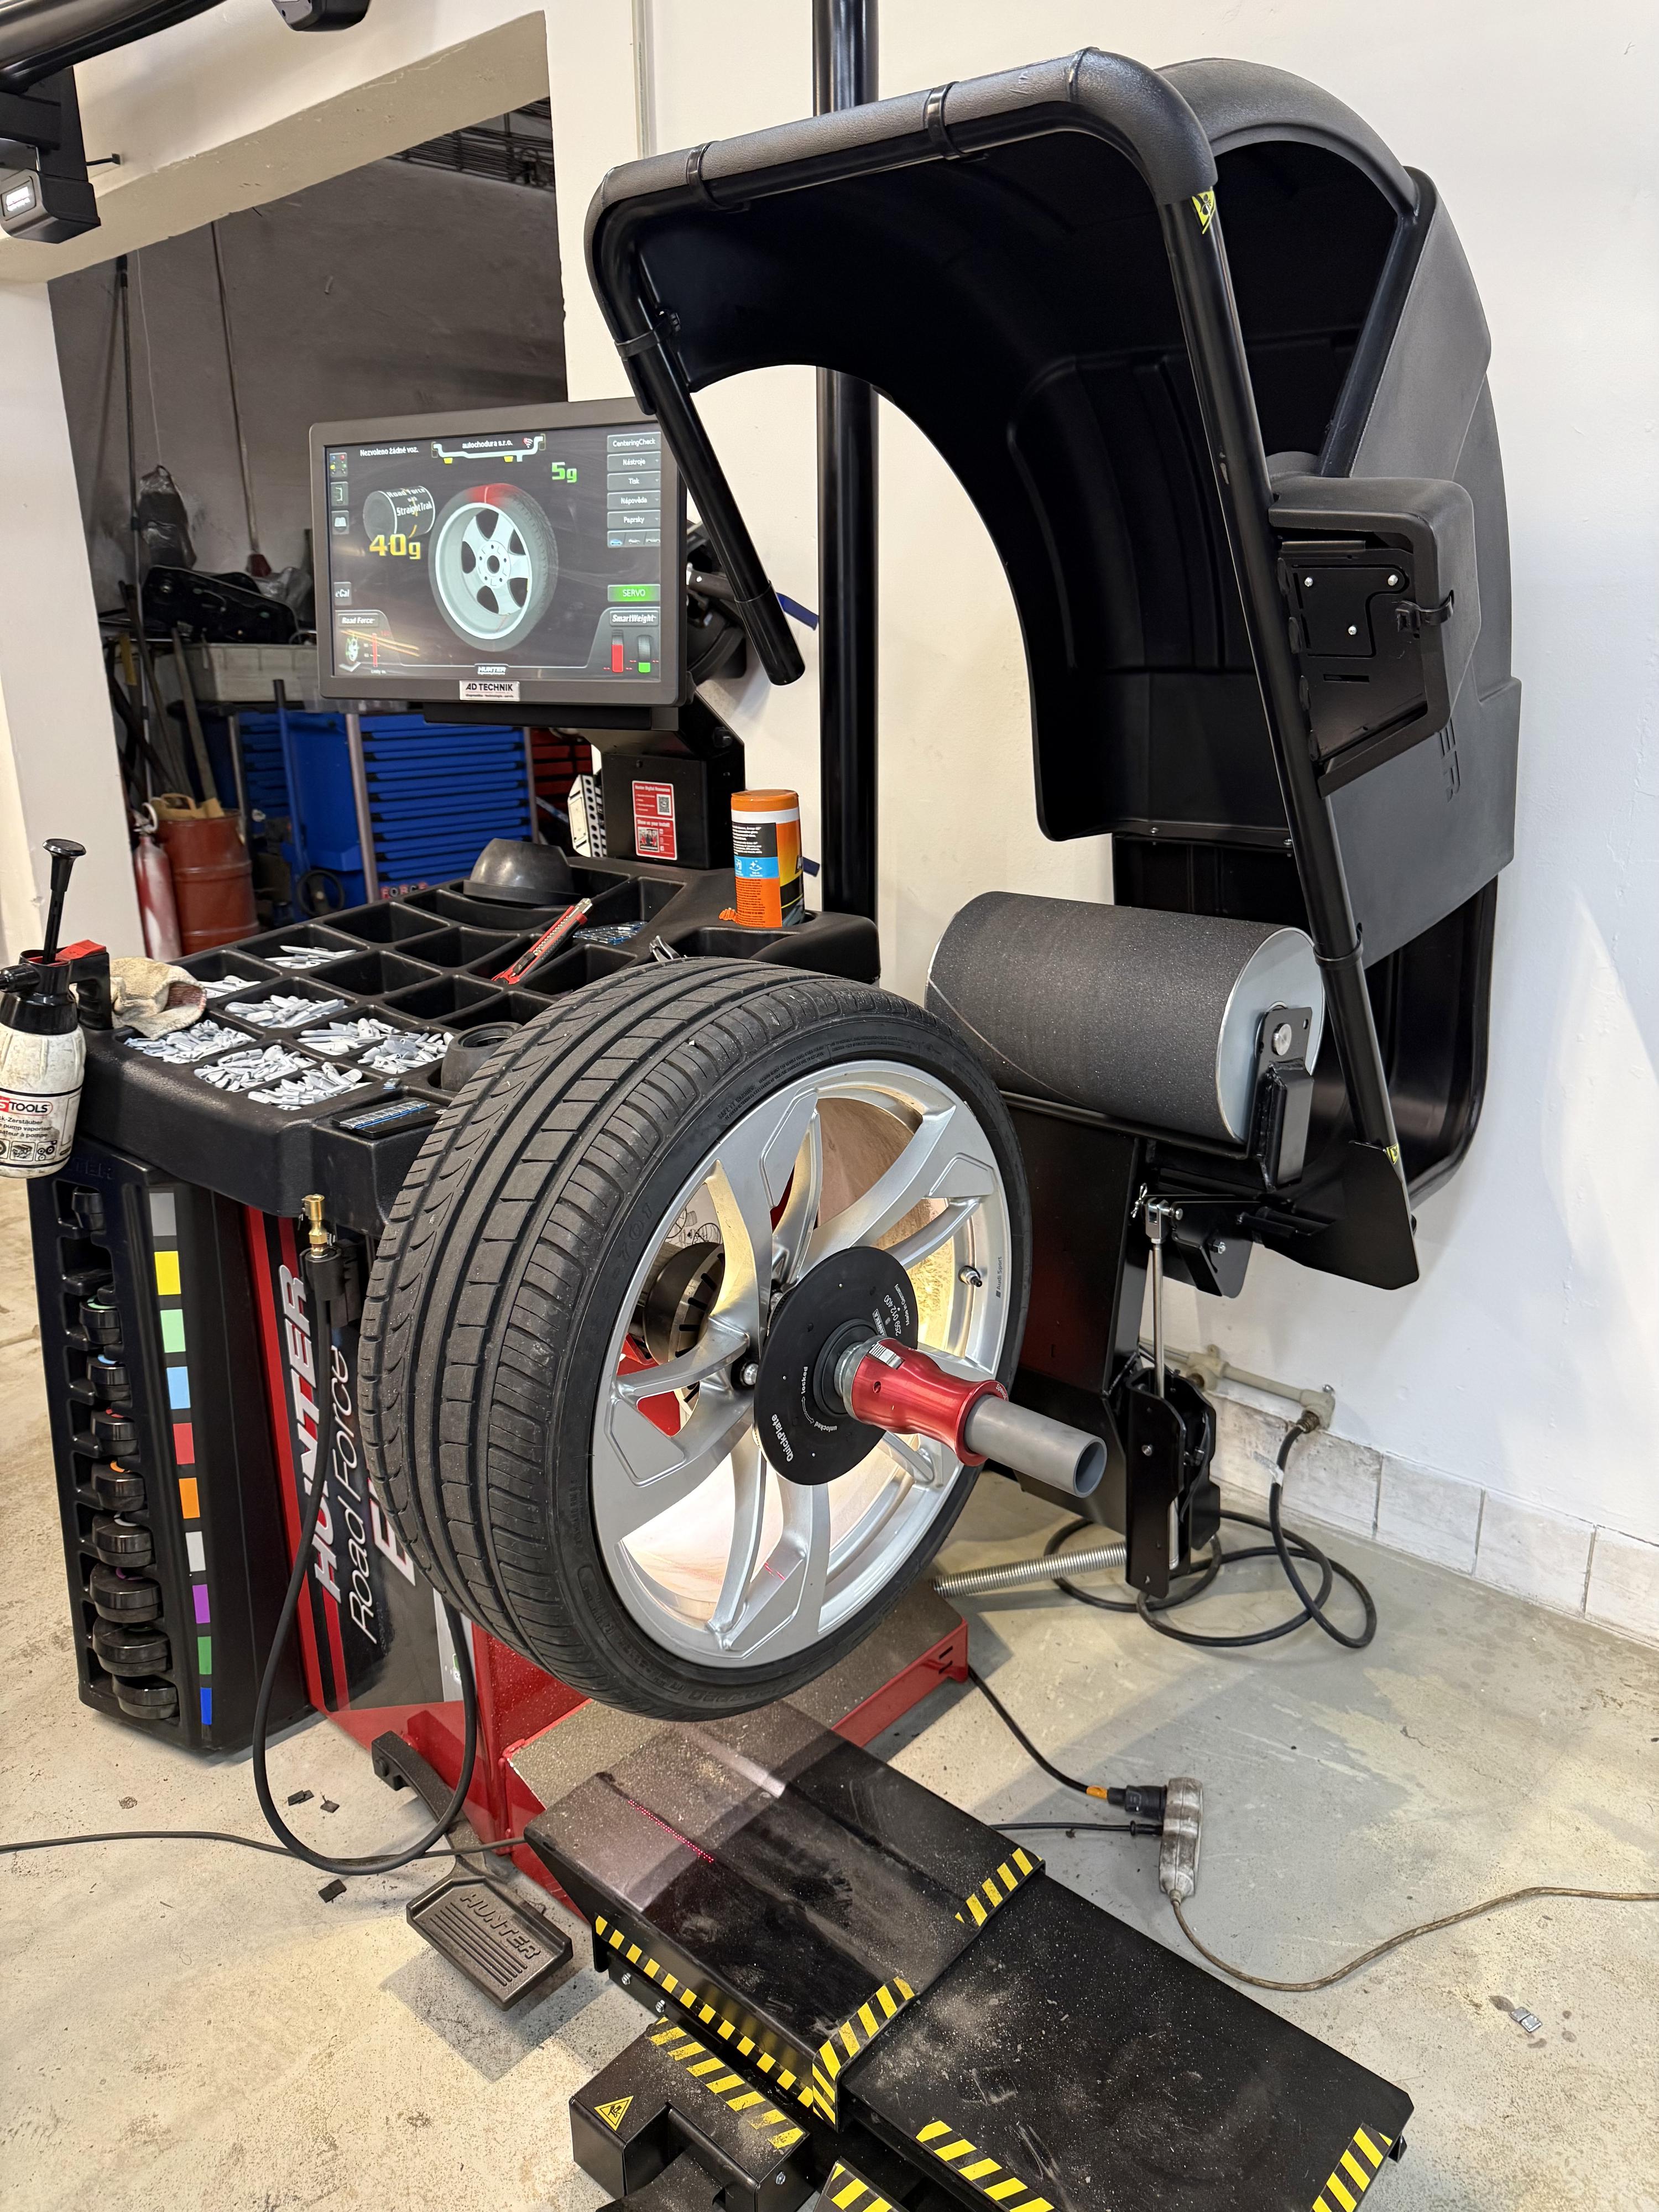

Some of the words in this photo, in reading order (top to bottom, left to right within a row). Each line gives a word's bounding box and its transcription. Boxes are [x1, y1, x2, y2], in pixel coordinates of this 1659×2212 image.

[613, 437, 655, 447] CenteringCheck
[360, 449, 388, 457] Nezvoleno
[623, 458, 646, 466] Nástroje
[552, 461, 577, 483] 5g
[620, 496, 648, 505] Nápověda
[623, 516, 645, 525] Paprsky
[369, 534, 421, 560] 40g
[335, 588, 350, 598] eCal
[623, 589, 646, 597] SERVO
[478, 683, 513, 691] TECHNIK
[9, 1101, 48, 1113] TOOLS
[884, 1295, 894, 1308] 400
[890, 1305, 899, 1321] 012
[332, 1345, 361, 1502] Force
[813, 1421, 838, 1432] unlocked
[771, 1413, 794, 1463] QuickPlate
[338, 1489, 376, 1644] Road
[459, 1893, 541, 1960] HUNTER
